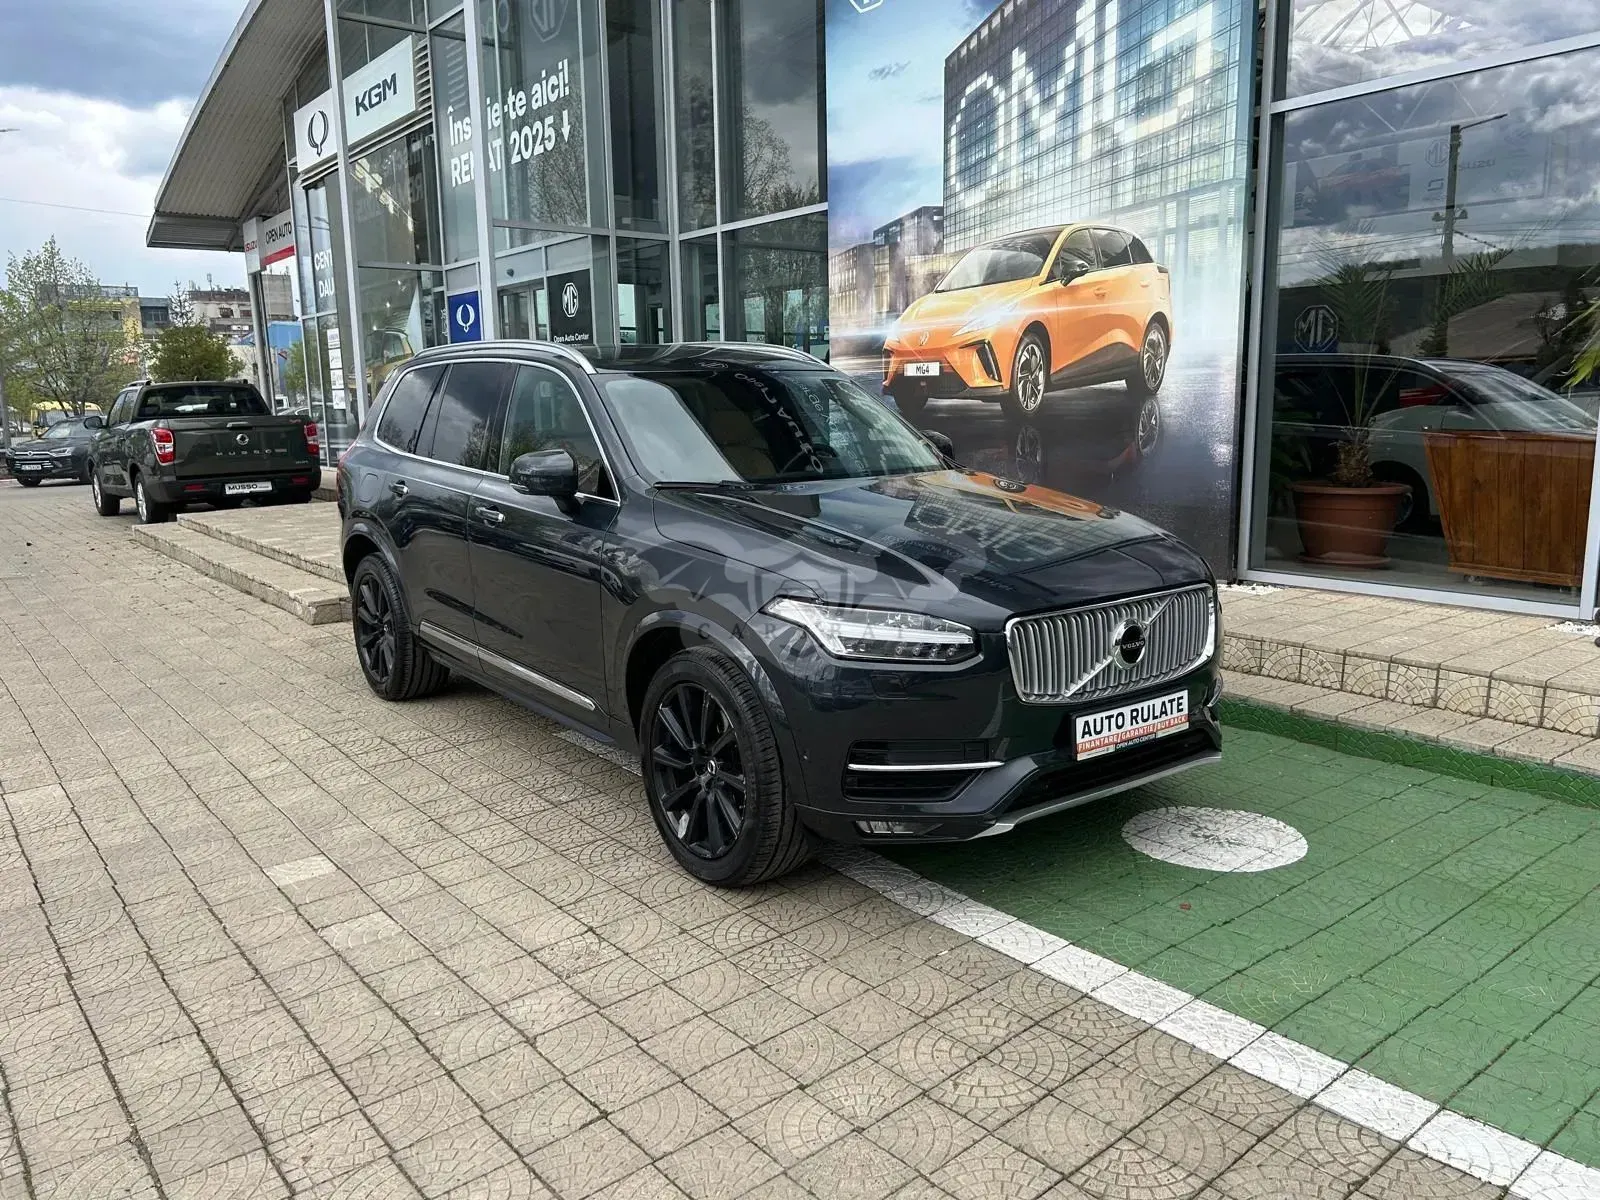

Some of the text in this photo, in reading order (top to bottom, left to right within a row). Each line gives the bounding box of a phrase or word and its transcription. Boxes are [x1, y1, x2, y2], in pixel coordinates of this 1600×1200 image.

[355, 73, 398, 117] KGM
[531, 58, 570, 111] aici!
[509, 115, 556, 165] 2025
[265, 221, 292, 244] OPEN AUTO
[914, 363, 930, 376] MG4
[227, 483, 258, 492] MUSSO
[1122, 640, 1144, 649] VOLVO
[1080, 695, 1184, 740] AUTO RULATE
[1170, 716, 1187, 728] BACK
